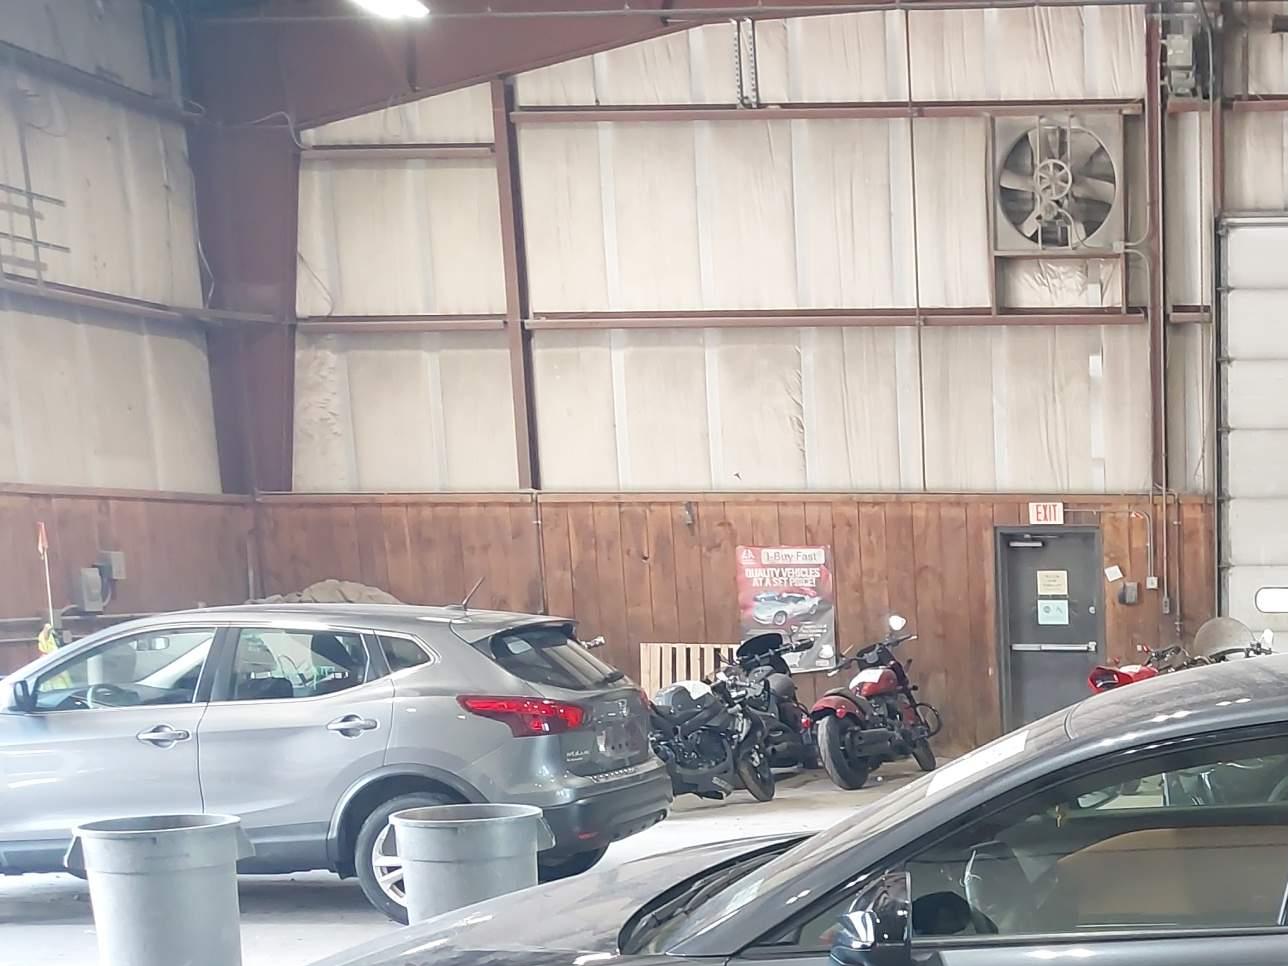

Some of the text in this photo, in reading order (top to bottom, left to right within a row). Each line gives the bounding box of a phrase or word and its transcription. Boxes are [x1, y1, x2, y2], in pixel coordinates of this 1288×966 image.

[1036, 504, 1057, 521] EXIT
[766, 551, 793, 562] I-Buy
[797, 551, 817, 561] Fast
[745, 567, 820, 578] QUALITY VEHICLES
[752, 577, 763, 587] AT
[765, 577, 772, 587] A
[773, 577, 788, 587] SET
